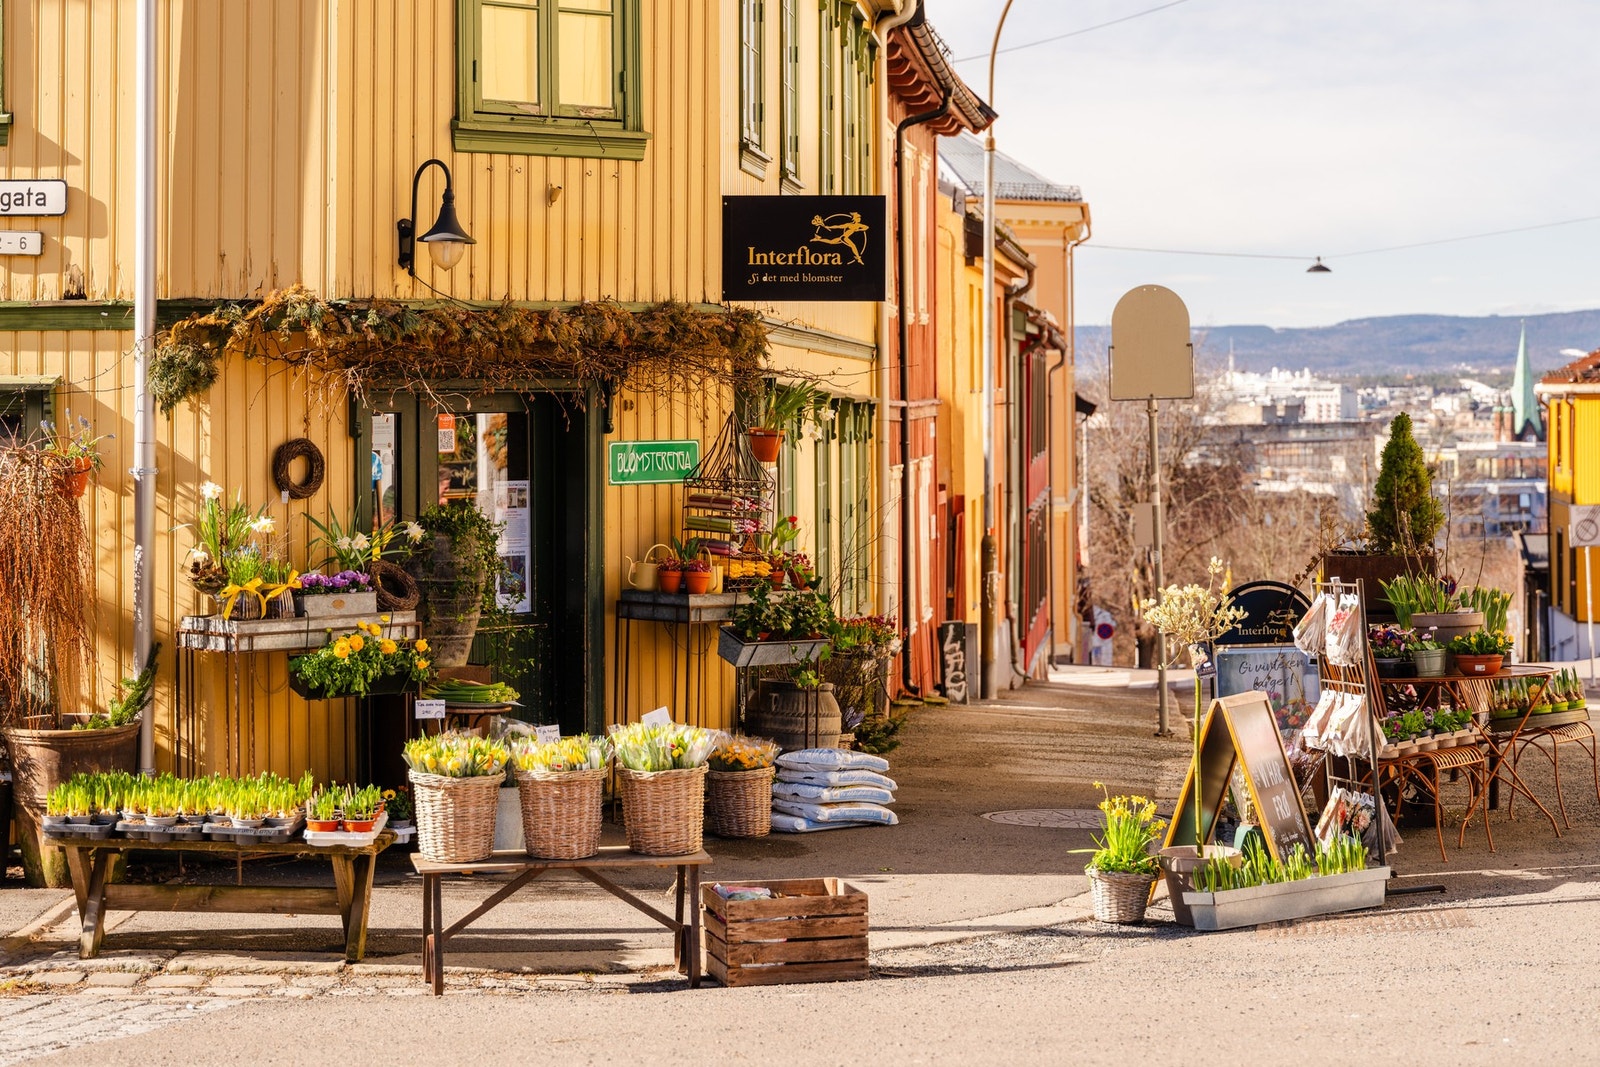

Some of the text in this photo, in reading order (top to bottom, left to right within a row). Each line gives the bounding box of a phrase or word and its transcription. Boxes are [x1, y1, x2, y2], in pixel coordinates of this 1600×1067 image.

[0, 187, 47, 212] gata
[19, 236, 27, 250] 6
[747, 245, 843, 266] Interflora
[747, 272, 843, 285] Si det med blomster
[1238, 624, 1281, 636] Interflor
[1238, 660, 1254, 675] Gi
[1253, 673, 1295, 694] farger!
[1271, 790, 1292, 821] FRØ
